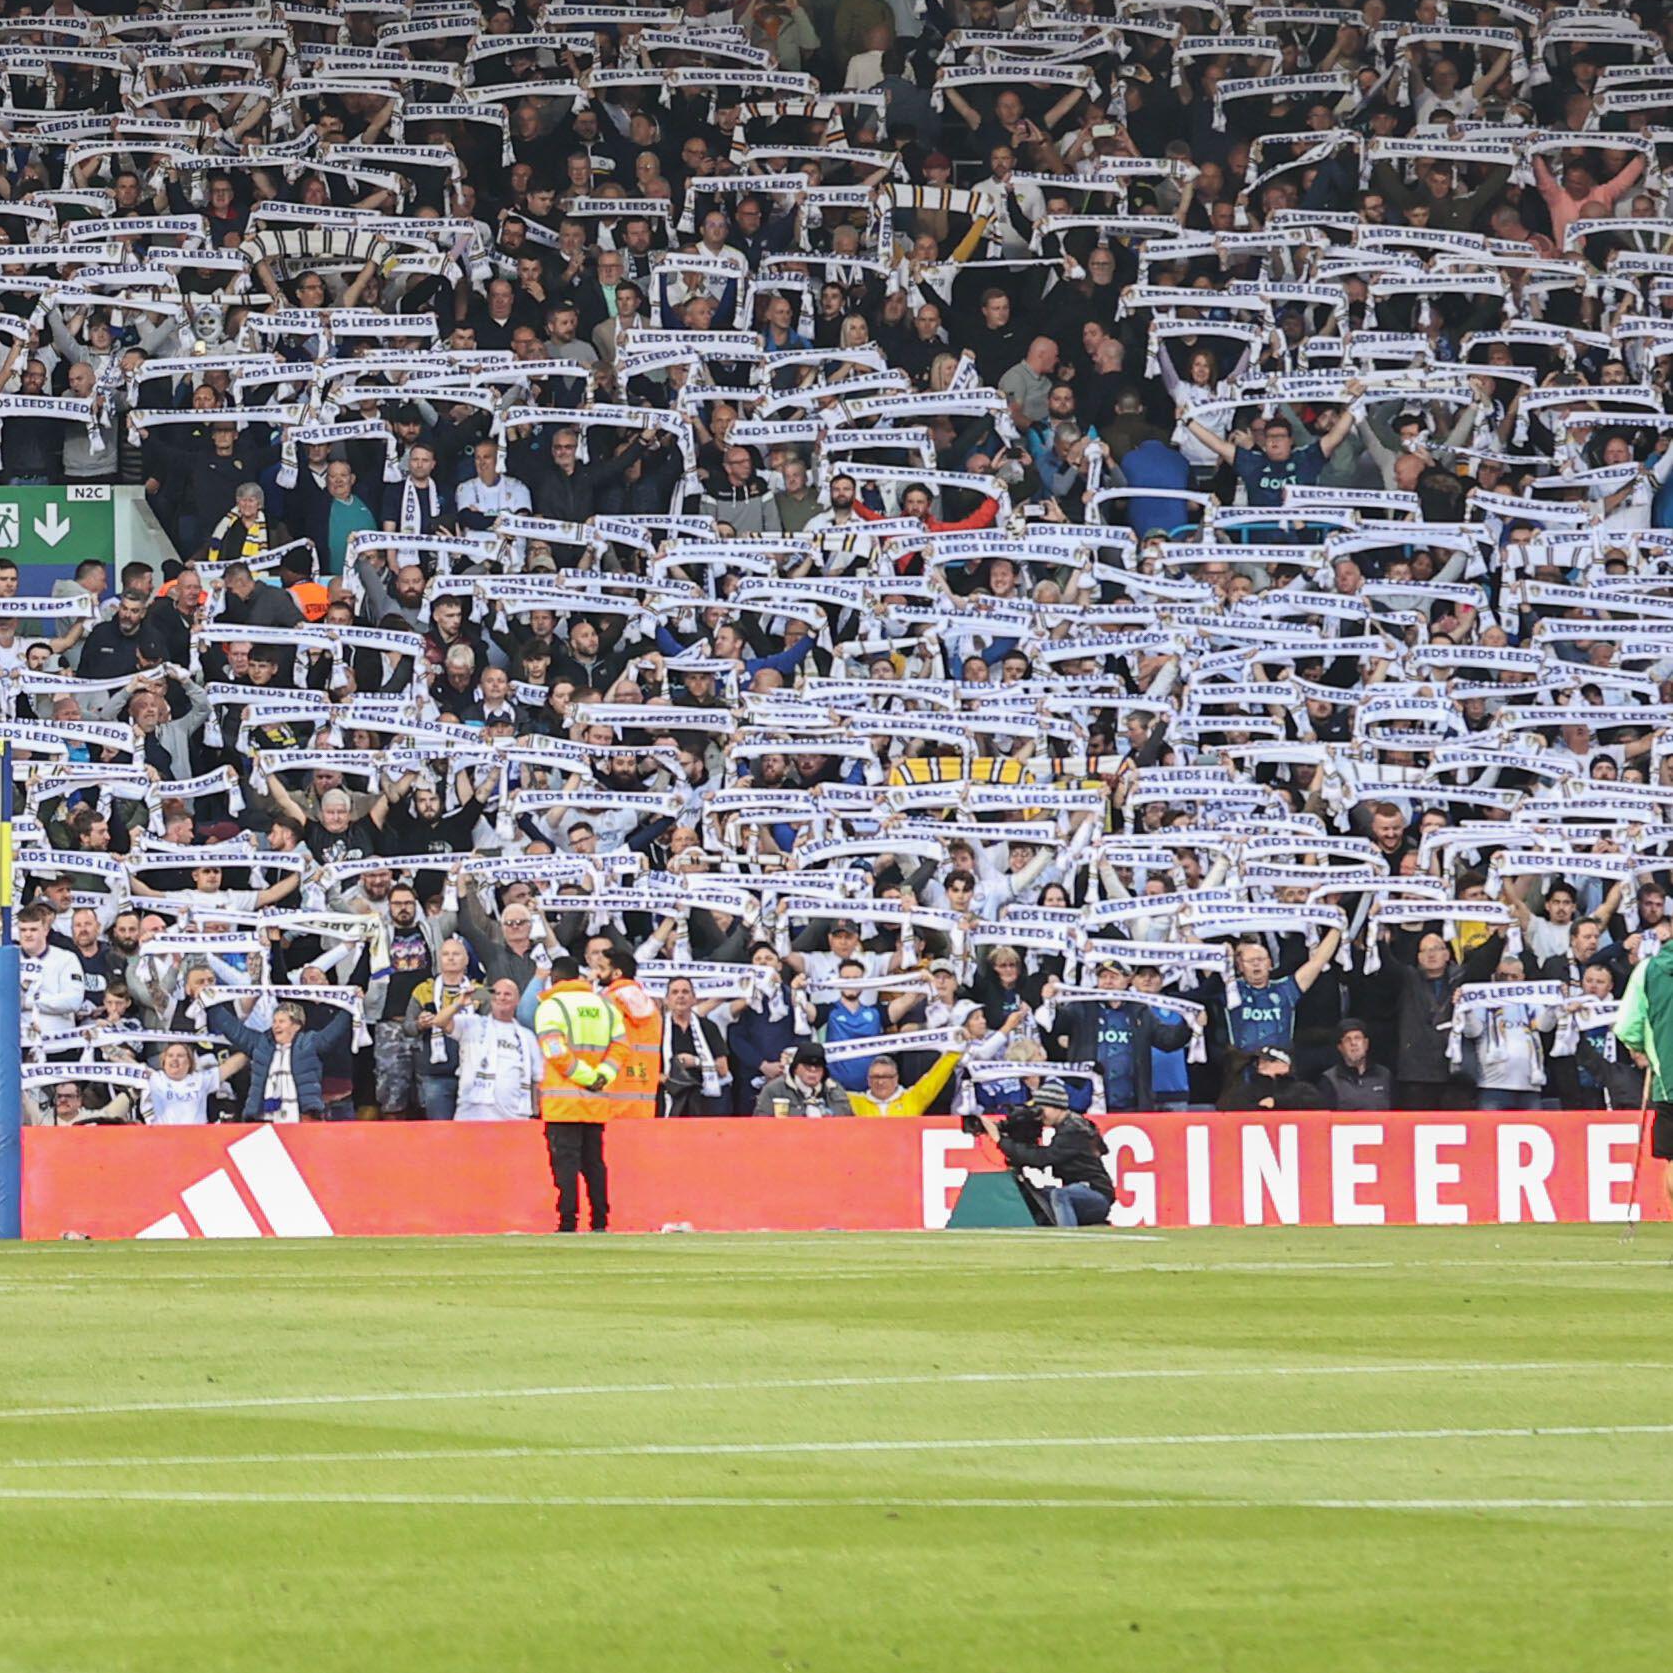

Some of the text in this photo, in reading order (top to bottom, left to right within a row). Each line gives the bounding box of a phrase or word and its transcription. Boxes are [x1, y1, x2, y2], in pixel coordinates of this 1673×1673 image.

[1384, 141, 1510, 155] LEEDS LEEDS LEEDS
[71, 221, 196, 235] LEEDS LEEDS LEEDS
[1362, 229, 1487, 251] LEEDS LEEDS LEEDS
[19, 246, 59, 257] LEEDS
[62, 244, 103, 255] LEEDS
[352, 316, 433, 327] LEEDS LEEDS
[74, 487, 104, 500] N2C
[405, 484, 414, 522] LEEDS
[939, 544, 1069, 557] LEEDS LEEDS LEEDS
[1546, 586, 1629, 603] LEEDS LEEDS
[1455, 649, 1541, 663] LEEDS LEEDS
[520, 792, 662, 805] LEEDS LEEDS LEEDS
[1510, 856, 1602, 870] LEEDS LEEDS
[1096, 891, 1231, 913] LEEDS LEEDS LEEDS
[1242, 1007, 1281, 1022] BOXT
[922, 1124, 1641, 1229] EGINEERE
